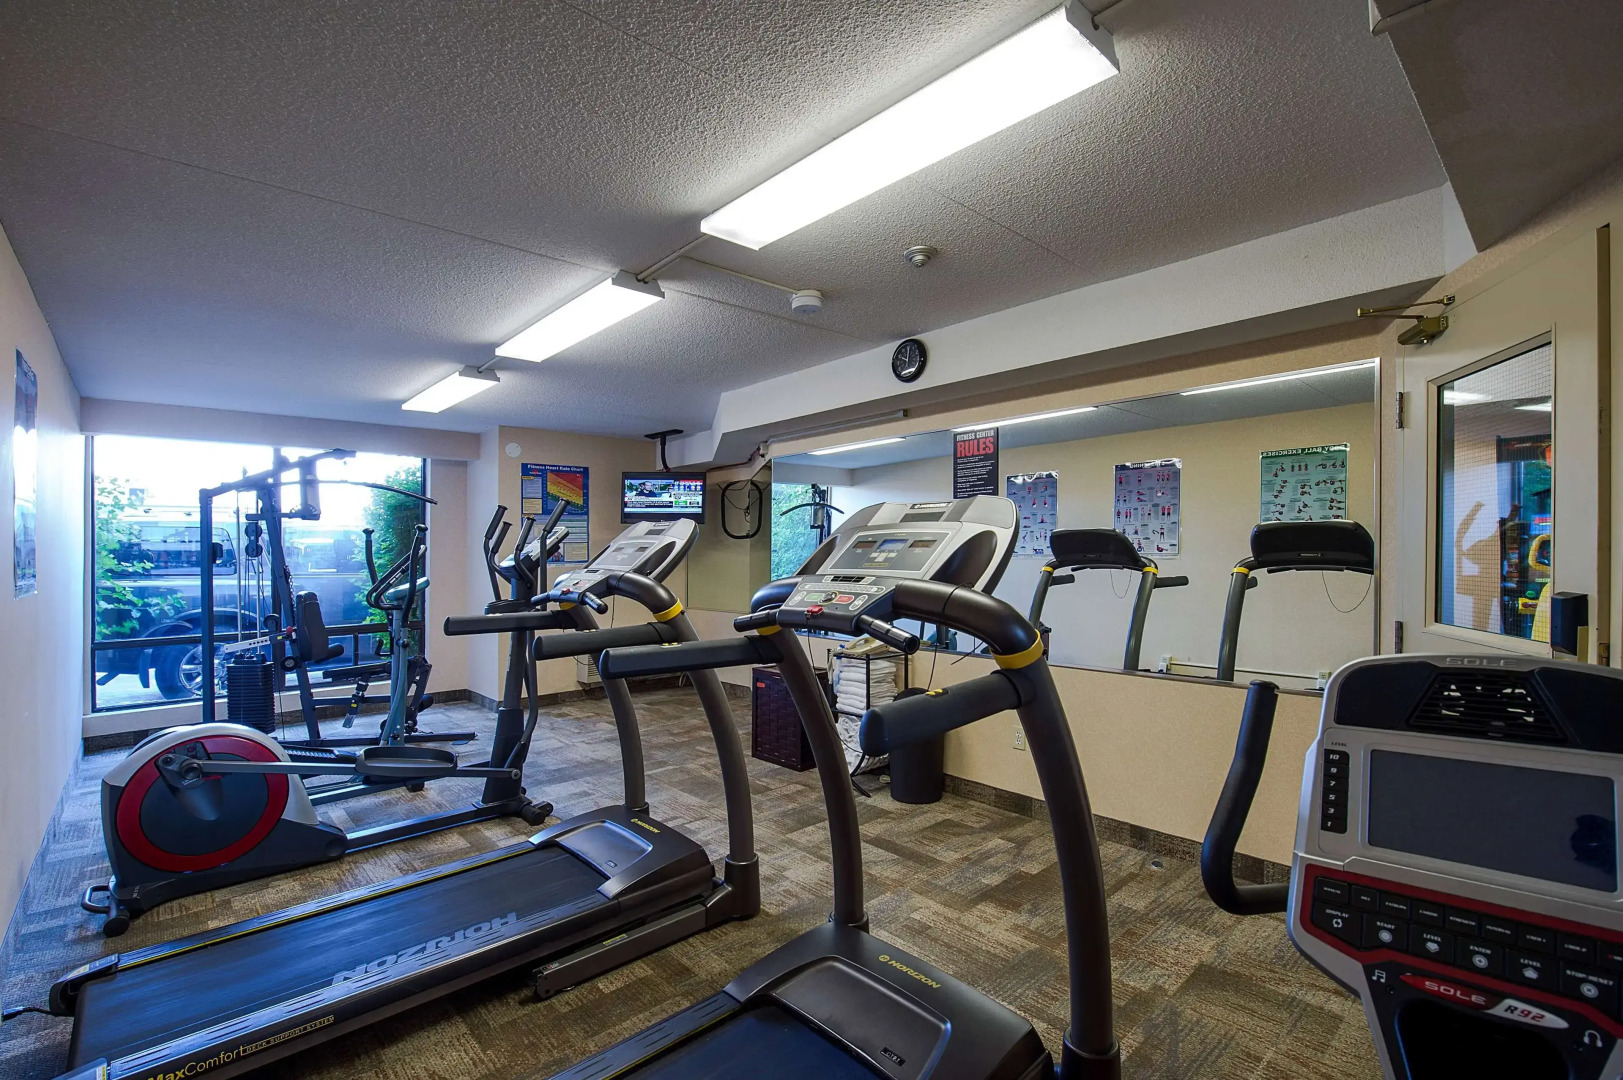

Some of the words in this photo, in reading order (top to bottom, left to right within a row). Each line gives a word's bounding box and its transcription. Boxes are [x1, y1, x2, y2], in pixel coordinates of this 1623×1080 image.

[956, 432, 976, 441] FITNESS
[976, 430, 995, 439] CENTER
[956, 437, 994, 457] RULES
[1446, 657, 1518, 667] SOLE
[1325, 908, 1349, 918] DISPLAY
[1376, 921, 1396, 929] START
[1423, 933, 1442, 942] LEVEL
[1469, 945, 1492, 955] ENTER
[1520, 958, 1542, 968] LEVEL
[887, 960, 942, 988] HORIZON
[1424, 981, 1488, 1006] SOLE
[1503, 1004, 1547, 1023] R92
[269, 1027, 304, 1045] SUPPORT
[306, 1016, 335, 1031] SYSTEM
